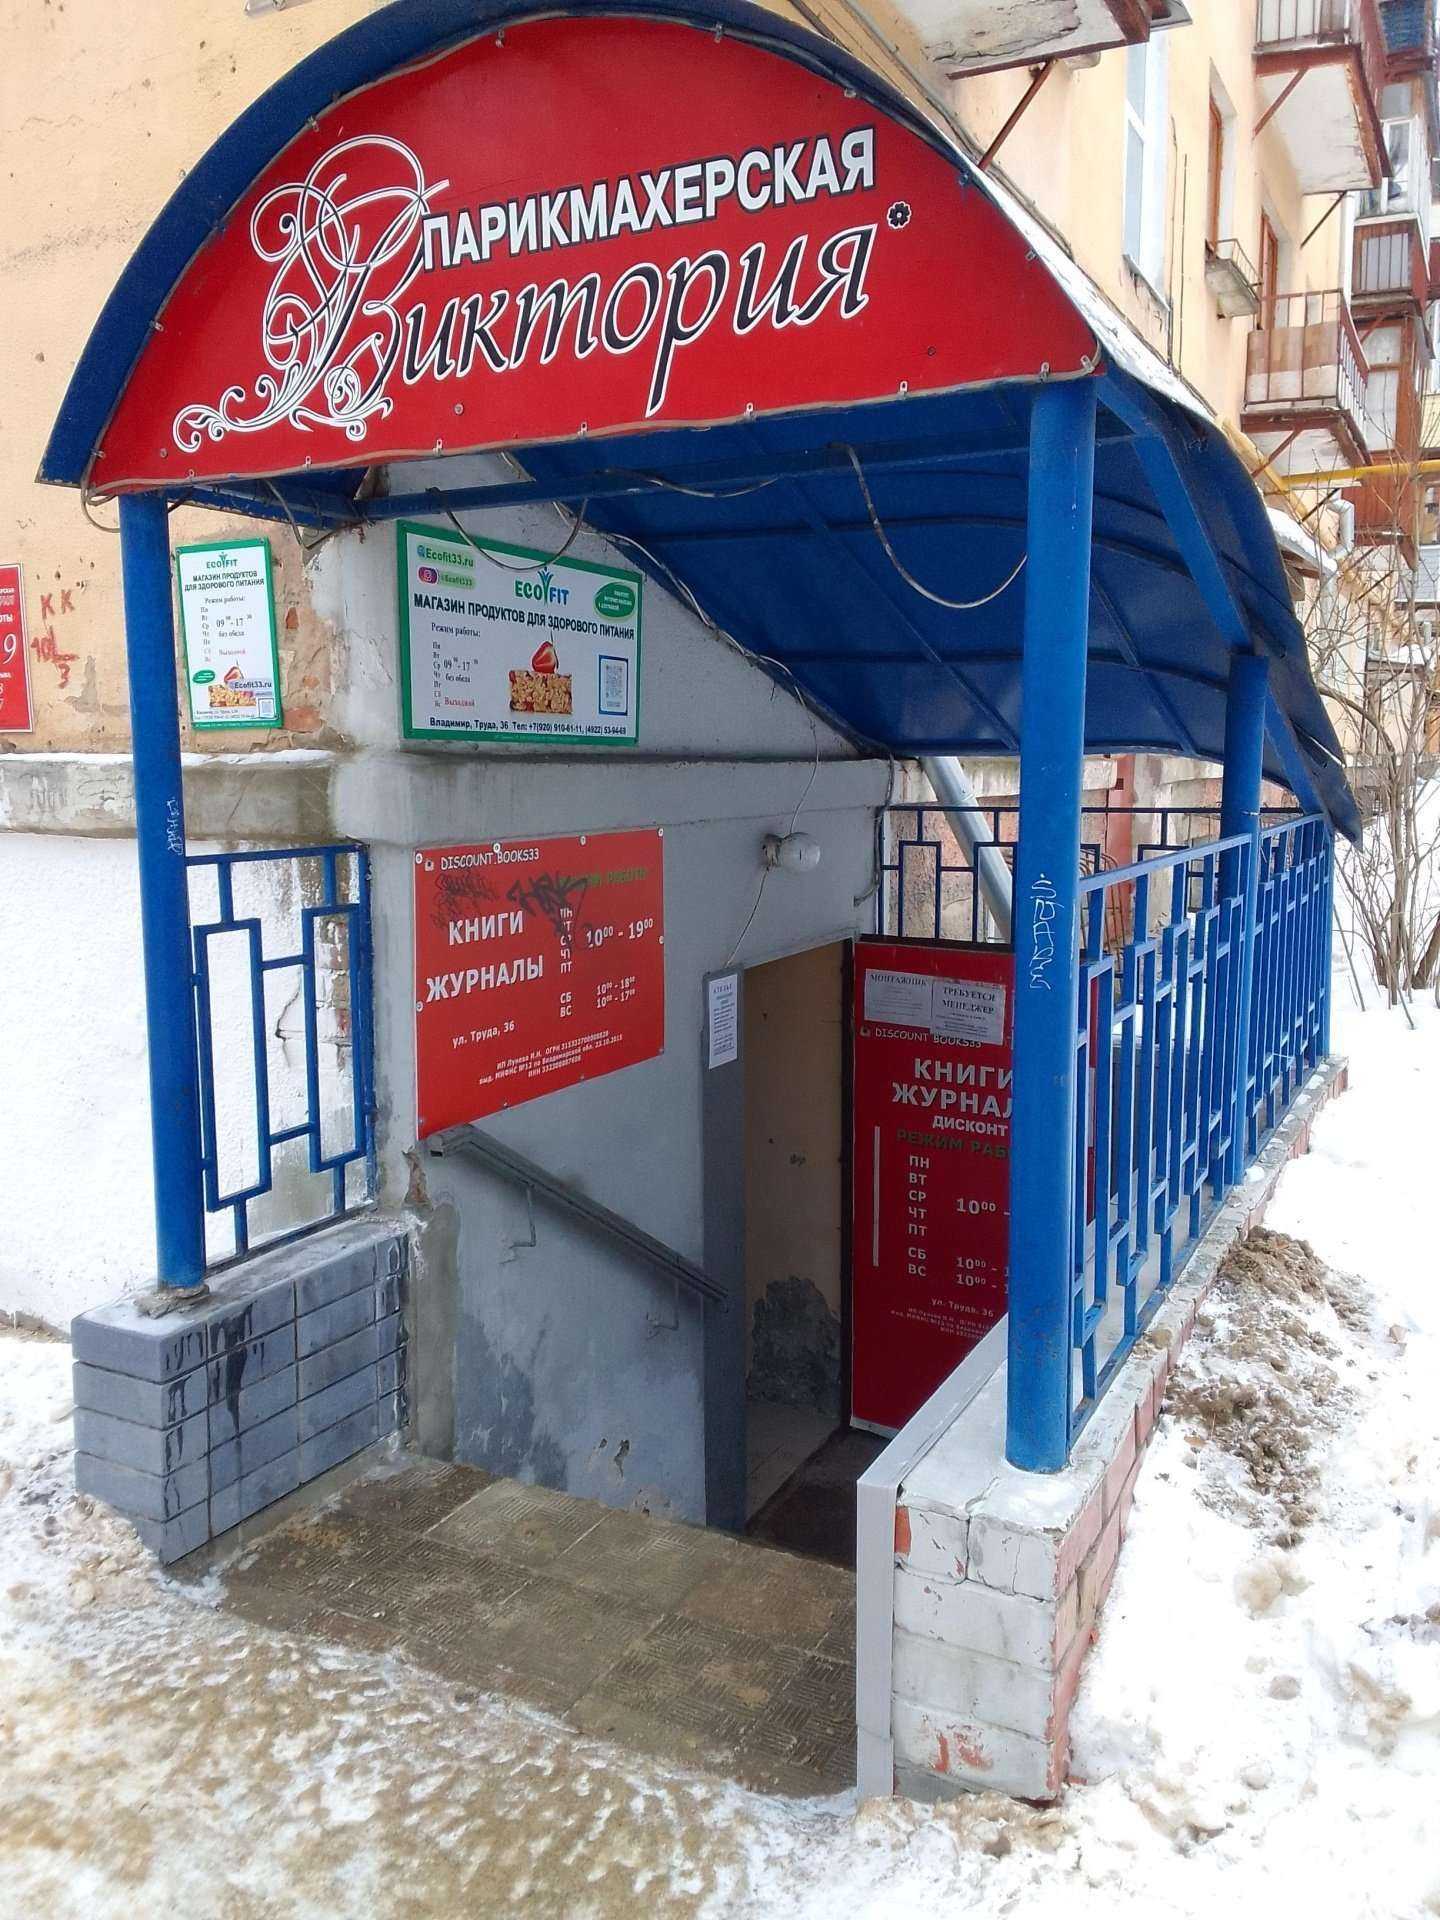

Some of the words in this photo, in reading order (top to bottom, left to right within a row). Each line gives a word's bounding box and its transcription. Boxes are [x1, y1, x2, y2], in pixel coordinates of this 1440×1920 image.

[422, 127, 877, 272] ПАРИКМАХЕРСКАЯ
[173, 134, 879, 453] Виктория
[193, 573, 221, 582] МАГАЗИН
[222, 570, 258, 580] ПРОДУКТОВ
[184, 583, 198, 592] ДЛЯ
[198, 580, 235, 590] ЗДОРОВОГО
[236, 578, 265, 587] ПИТАНИЯ
[413, 592, 465, 615] МАГАЗИН
[467, 601, 525, 624] ПРОДУКТОВ
[526, 612, 546, 628] ДЛЯ
[547, 615, 598, 635] ЗДОРОВОГО
[599, 624, 635, 641] ПИТАНИЯ
[431, 622, 454, 635] Режим
[234, 680, 273, 689] Ecofit33.ru
[429, 716, 473, 731] Владимир,
[474, 719, 499, 731] Труда,
[500, 720, 509, 730] 36
[448, 910, 524, 947] КНИГИ
[560, 960, 573, 974] ПТ
[425, 954, 544, 1004] ЖУРНАЛЫ
[870, 973, 927, 987] МОНТАЖНИК
[560, 991, 573, 1005] СБ
[943, 986, 996, 1002] ТРЕБУЕТСЯ
[560, 1005, 573, 1018] ВС
[942, 999, 995, 1015] МЕНЕДЖЕР
[452, 1036, 468, 1049] ул.
[470, 1026, 501, 1042] Труда,
[503, 1020, 515, 1033] 36
[875, 1027, 929, 1042] DISCOUNT
[914, 1058, 1013, 1090] КНИГИ
[892, 1081, 1013, 1119] ЖУРНАЛ
[932, 1115, 1009, 1137] ДИСКОНТ
[896, 1128, 965, 1150] РЕЖИМ
[909, 1155, 930, 1169] ПН
[909, 1172, 928, 1185] ВТ
[908, 1190, 926, 1203] СР
[908, 1206, 928, 1219] ЧТ
[908, 1223, 928, 1237] ПТ
[908, 1246, 927, 1260] СБ
[908, 1263, 927, 1277] ВС
[982, 1308, 994, 1319] 36
